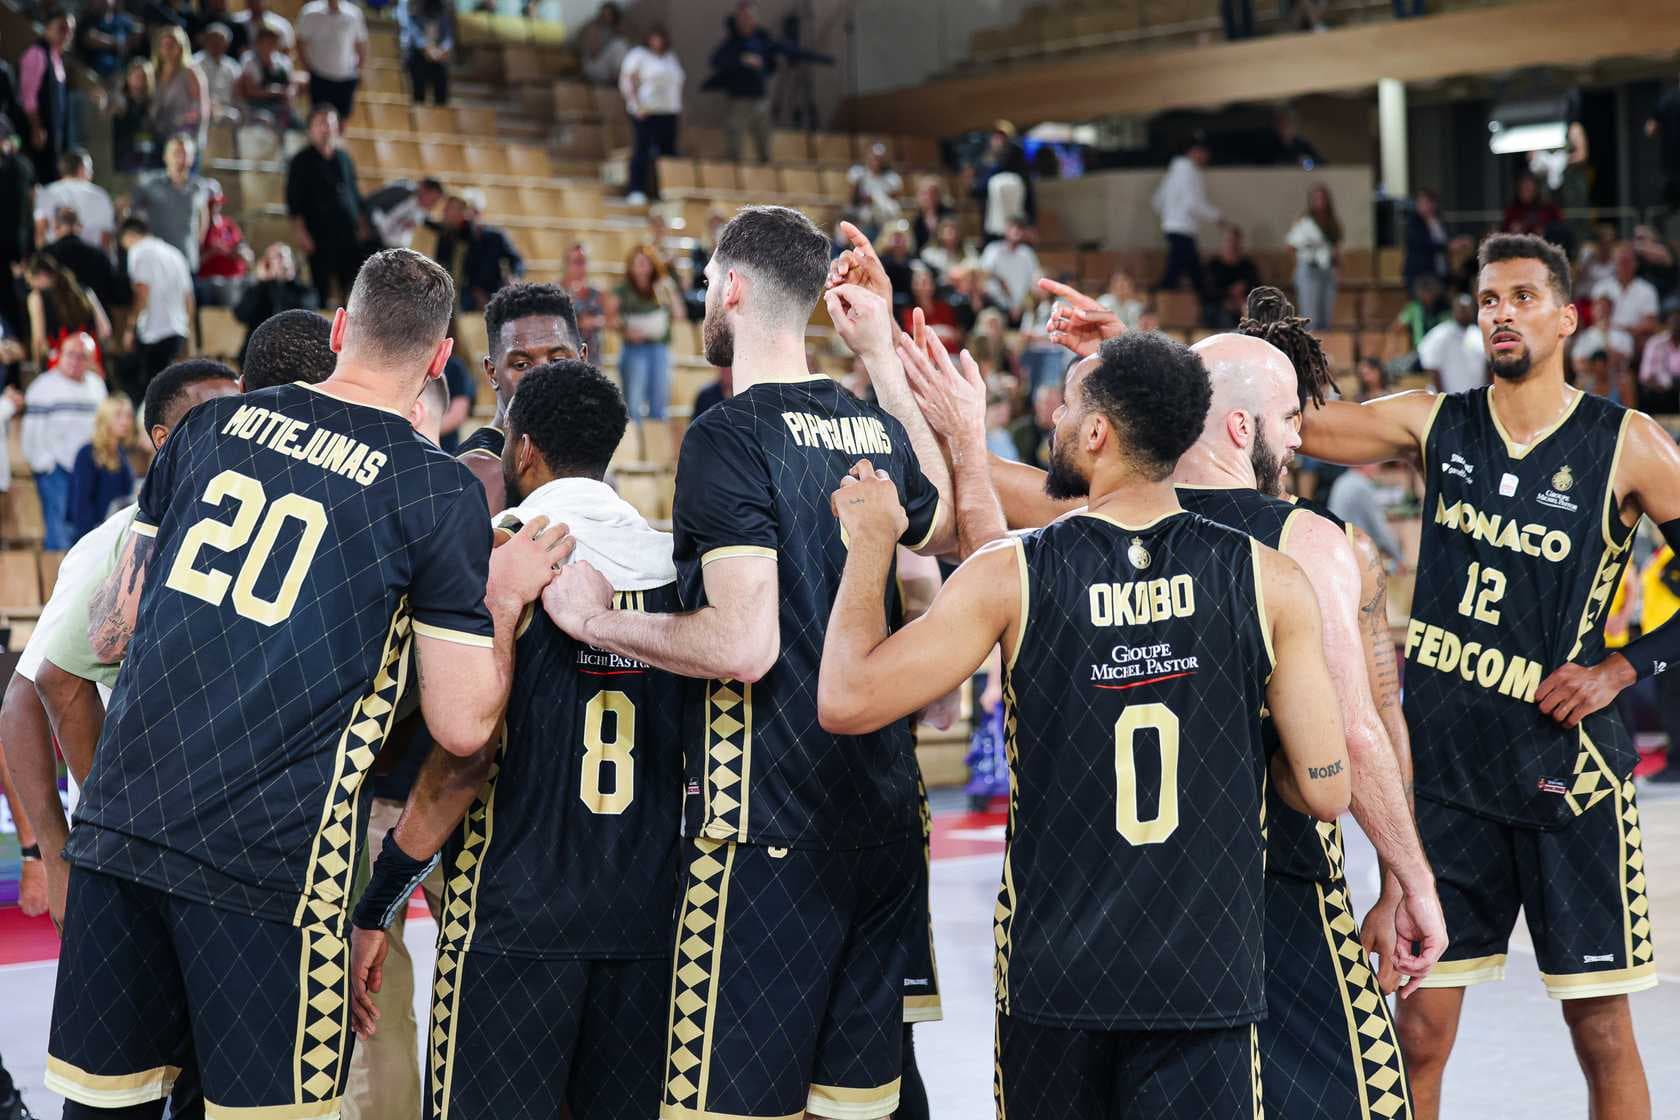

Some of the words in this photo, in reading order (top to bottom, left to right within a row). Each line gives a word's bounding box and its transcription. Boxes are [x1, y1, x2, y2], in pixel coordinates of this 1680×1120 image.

[221, 404, 387, 487] MOTIEJUNAS
[165, 469, 328, 627] 20
[1434, 492, 1571, 562] MONACO
[1458, 561, 1507, 626] 12
[1111, 643, 1172, 663] GOUPE
[1146, 656, 1199, 675] PASTOR
[1404, 618, 1543, 704] FEDCOM
[580, 690, 635, 814] 8
[1115, 702, 1179, 846] 0
[1308, 760, 1344, 779] WORK
